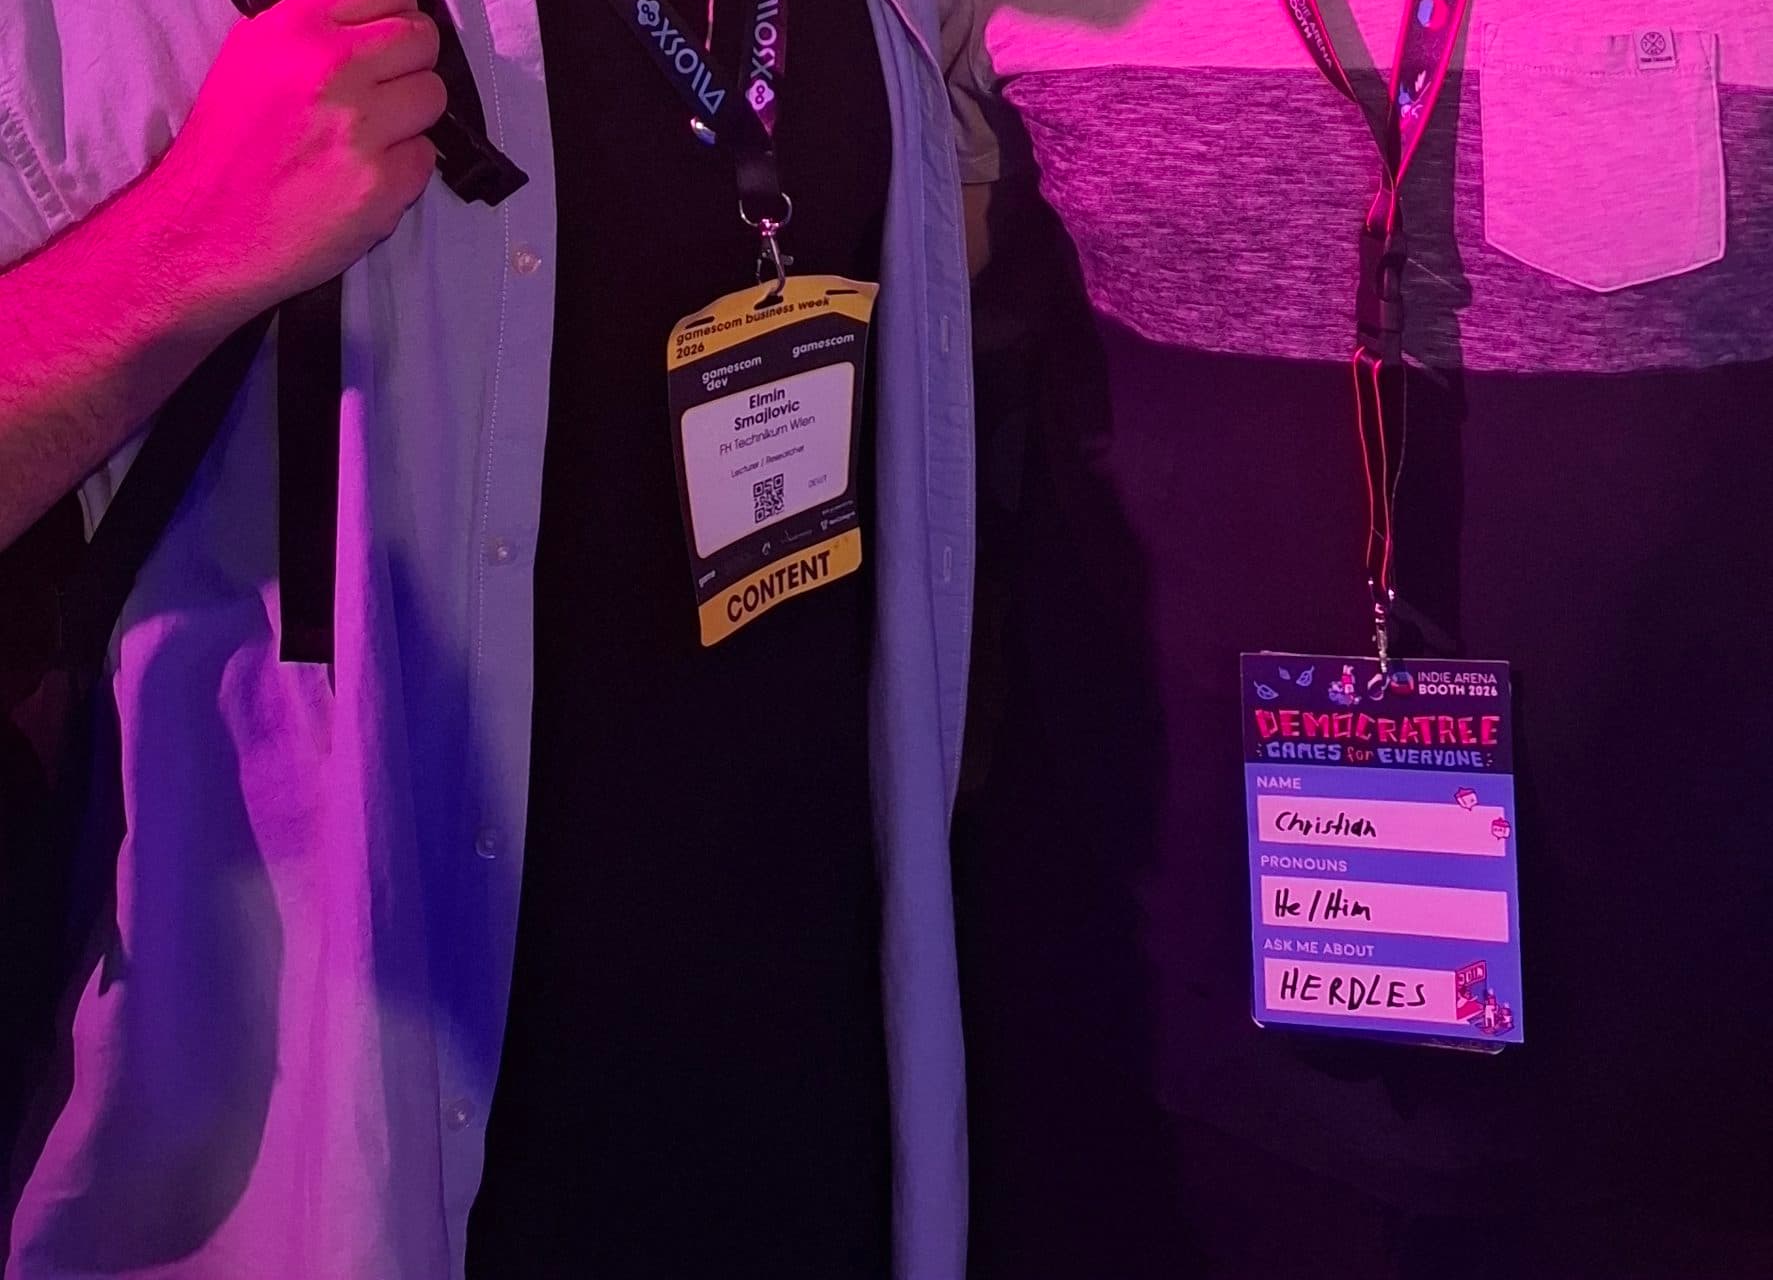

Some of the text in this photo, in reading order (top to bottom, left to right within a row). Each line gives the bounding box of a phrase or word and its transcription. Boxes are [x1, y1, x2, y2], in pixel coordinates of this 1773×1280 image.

[676, 296, 831, 346] gamescom business week
[676, 341, 706, 359] 2026
[792, 333, 855, 358] gamescom
[702, 355, 762, 384] gamescom
[706, 376, 728, 392] dev
[749, 387, 786, 409] Elmin
[734, 399, 800, 431] Smajlovic
[720, 415, 816, 455] FH Technikum Wien
[727, 549, 831, 623] CONTENT
[1418, 671, 1497, 684] INDIE ARENA
[1418, 684, 1498, 697] BOOTH 2026
[1254, 709, 1501, 745] DEMOCRATREE
[1266, 741, 1342, 761] GAMES
[1377, 747, 1484, 768] EVERYONE
[1256, 776, 1302, 790] NAME
[1275, 811, 1377, 838] Christian
[1260, 855, 1348, 873] PRONOUNS
[1263, 938, 1376, 957] ASK ME ABOUT
[1280, 967, 1426, 1010] HERDLES
